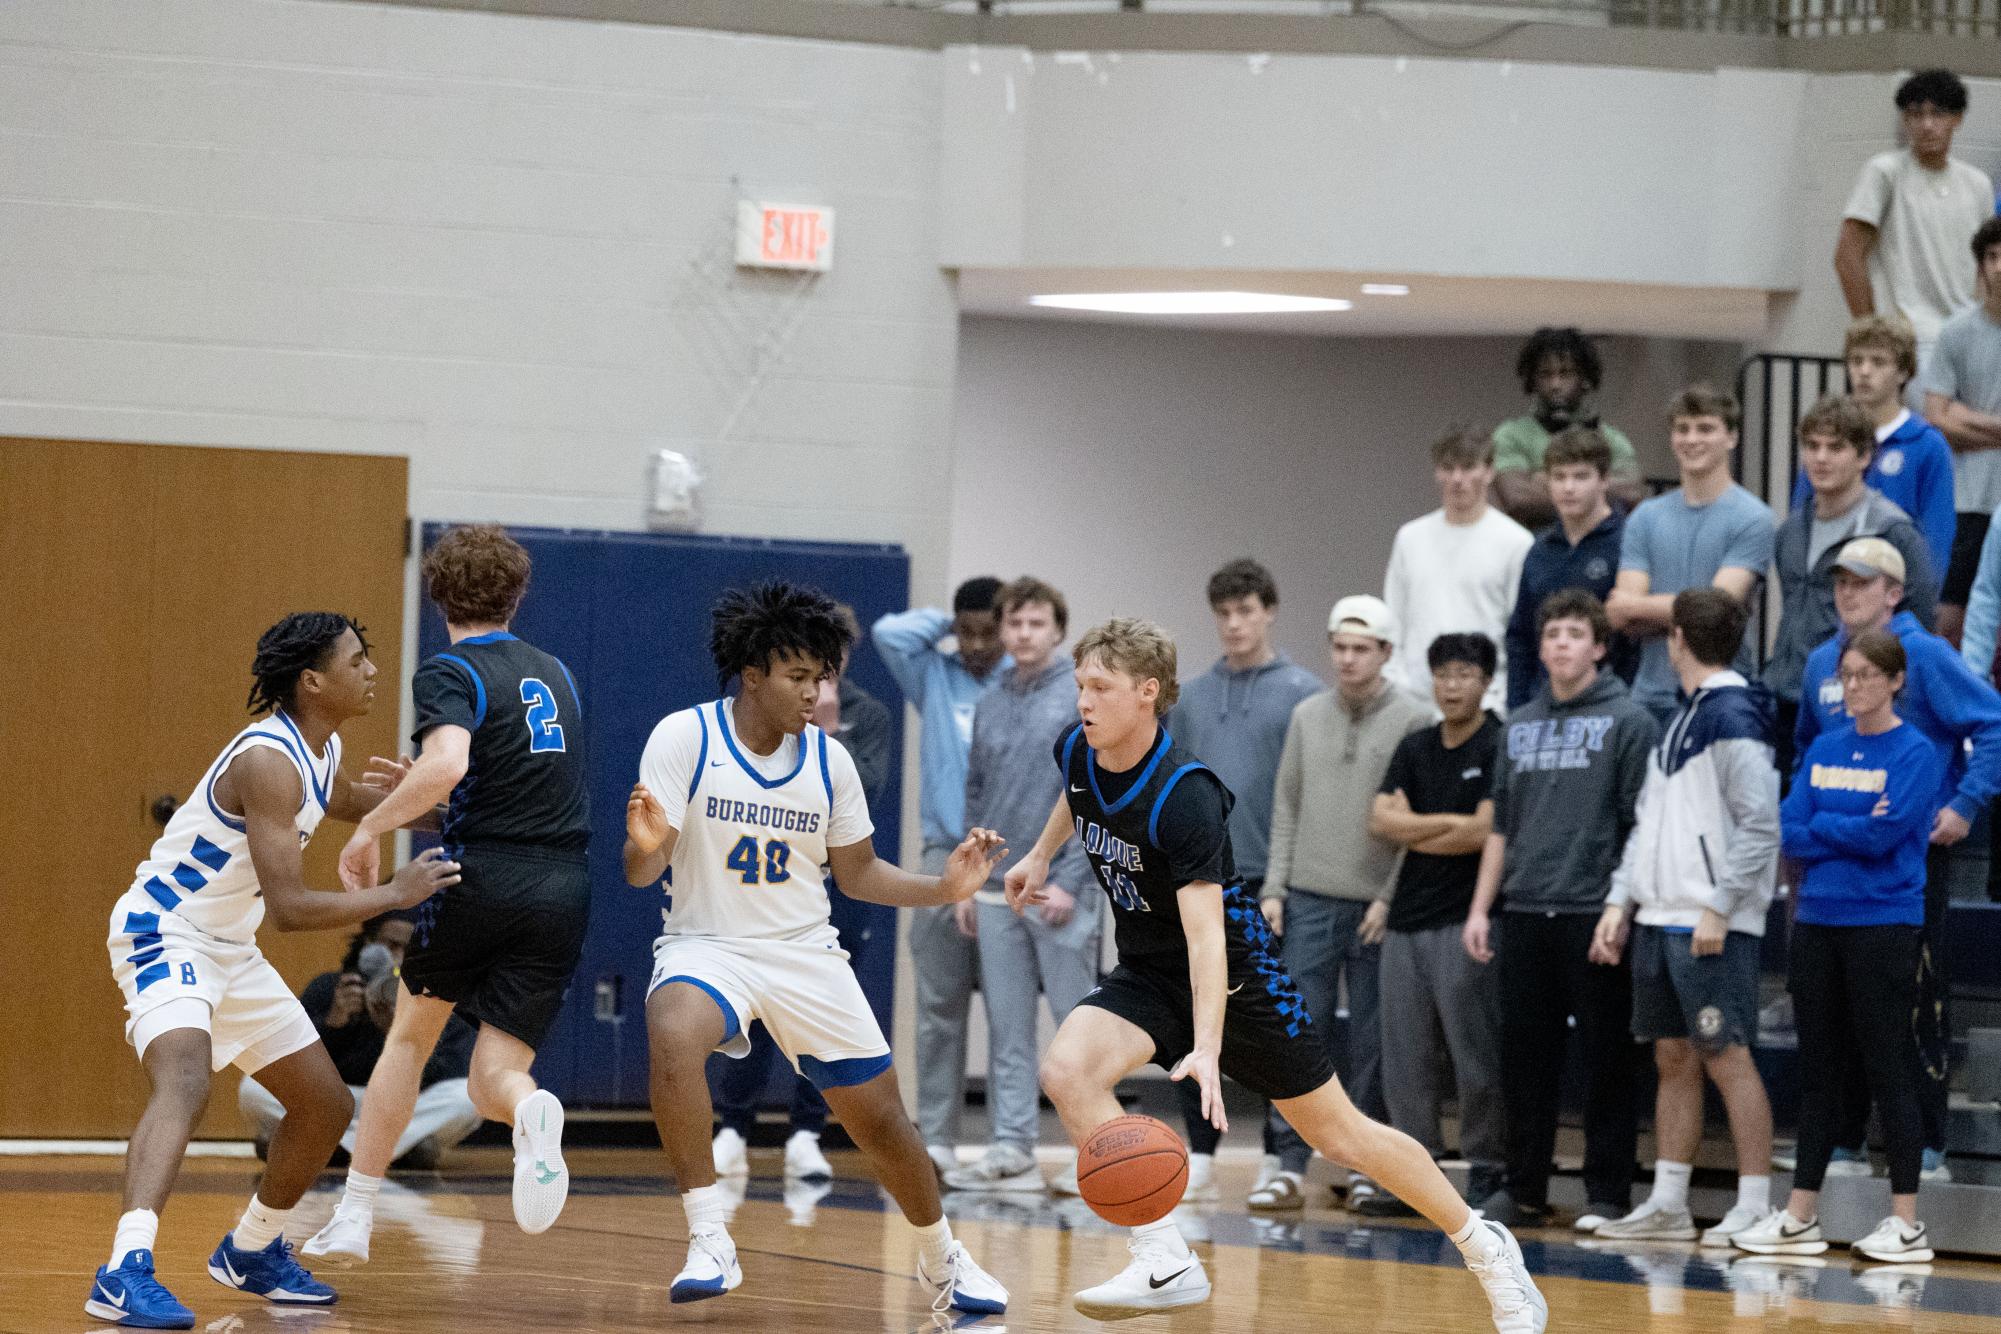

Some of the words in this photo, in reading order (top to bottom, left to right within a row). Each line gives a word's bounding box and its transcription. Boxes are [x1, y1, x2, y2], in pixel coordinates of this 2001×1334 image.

[763, 209, 822, 262] EXIT
[519, 677, 566, 753] 2
[706, 796, 821, 834] BURROUGHS
[725, 833, 791, 886] 40
[180, 961, 197, 985] B
